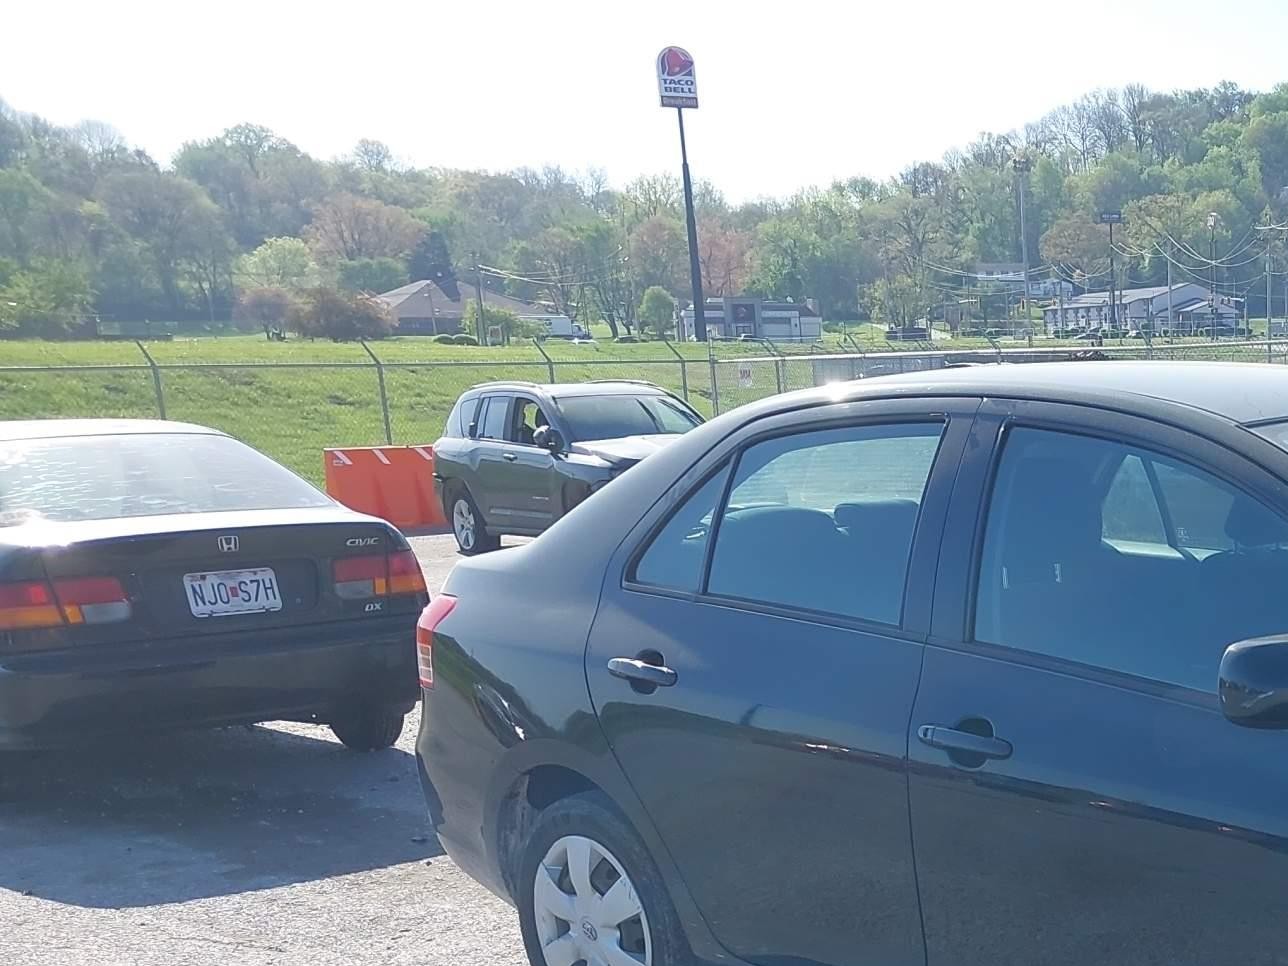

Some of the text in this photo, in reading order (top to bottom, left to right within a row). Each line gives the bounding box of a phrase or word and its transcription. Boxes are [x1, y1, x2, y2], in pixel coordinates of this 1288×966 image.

[664, 86, 696, 94] BELL
[346, 536, 380, 546] CIVIC
[238, 577, 277, 603] S7H
[365, 602, 384, 612] DX
